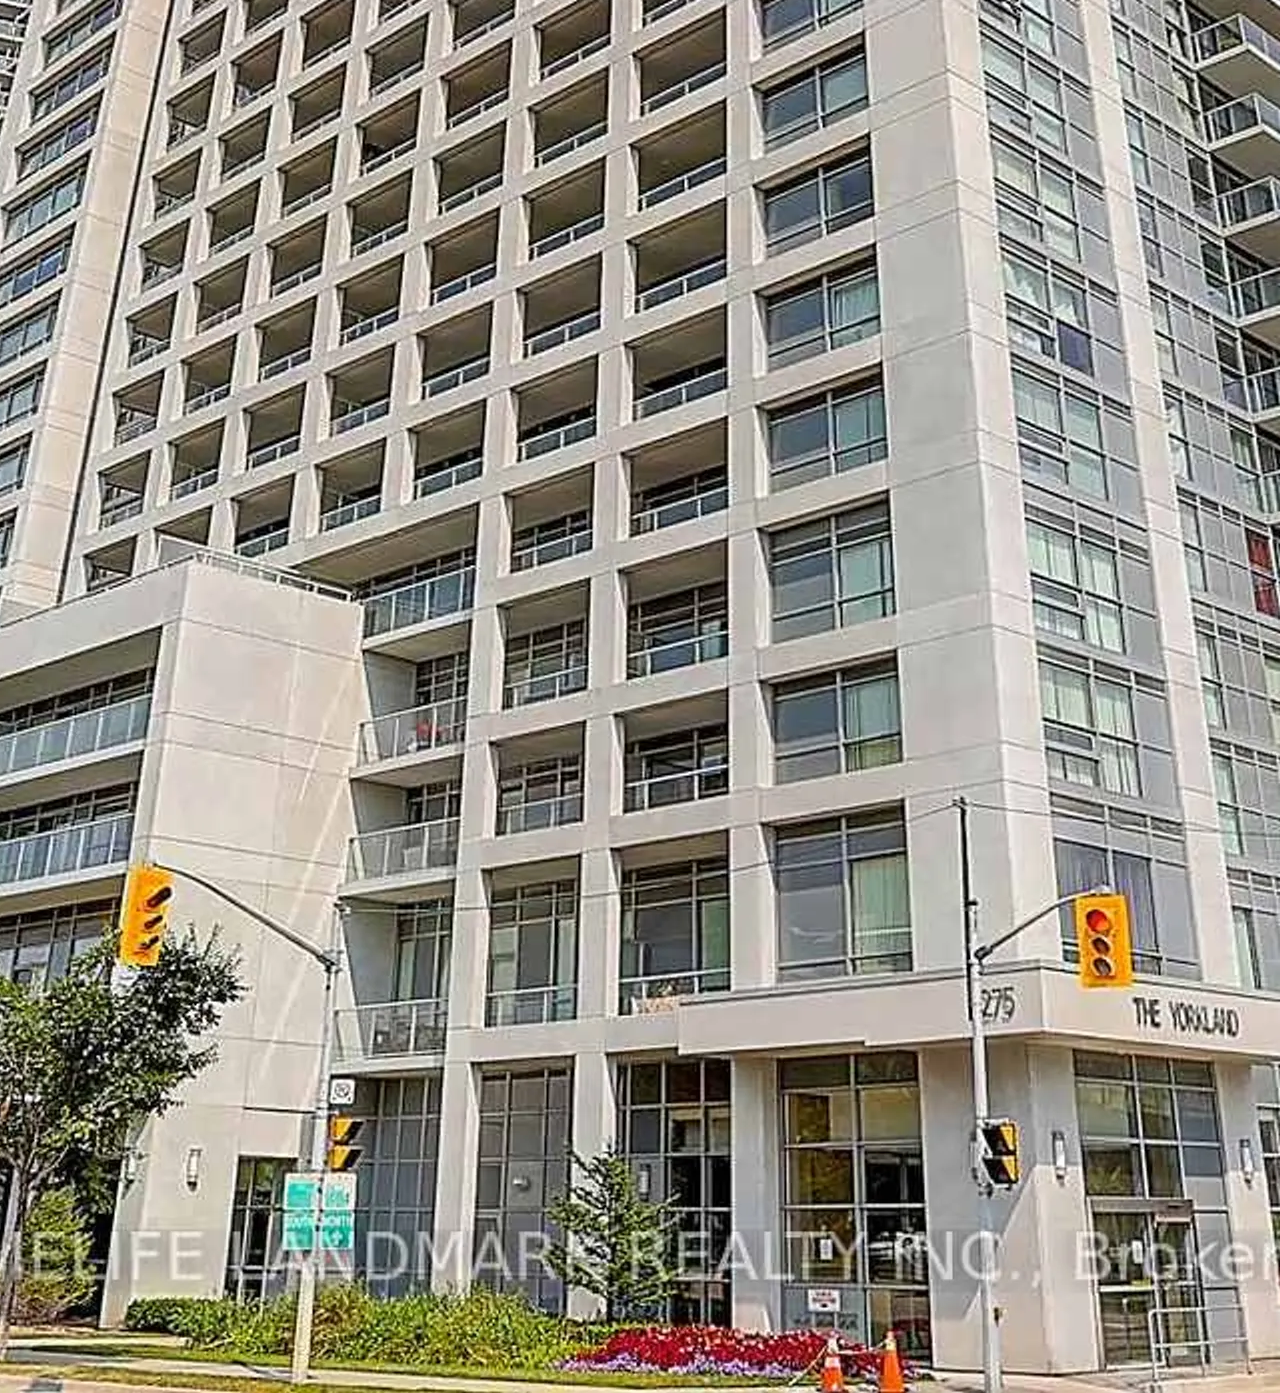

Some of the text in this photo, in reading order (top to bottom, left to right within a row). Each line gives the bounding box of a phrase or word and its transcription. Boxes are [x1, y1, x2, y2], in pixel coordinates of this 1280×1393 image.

[981, 986, 1016, 1021] 275
[1133, 996, 1240, 1038] THE YORKLAND
